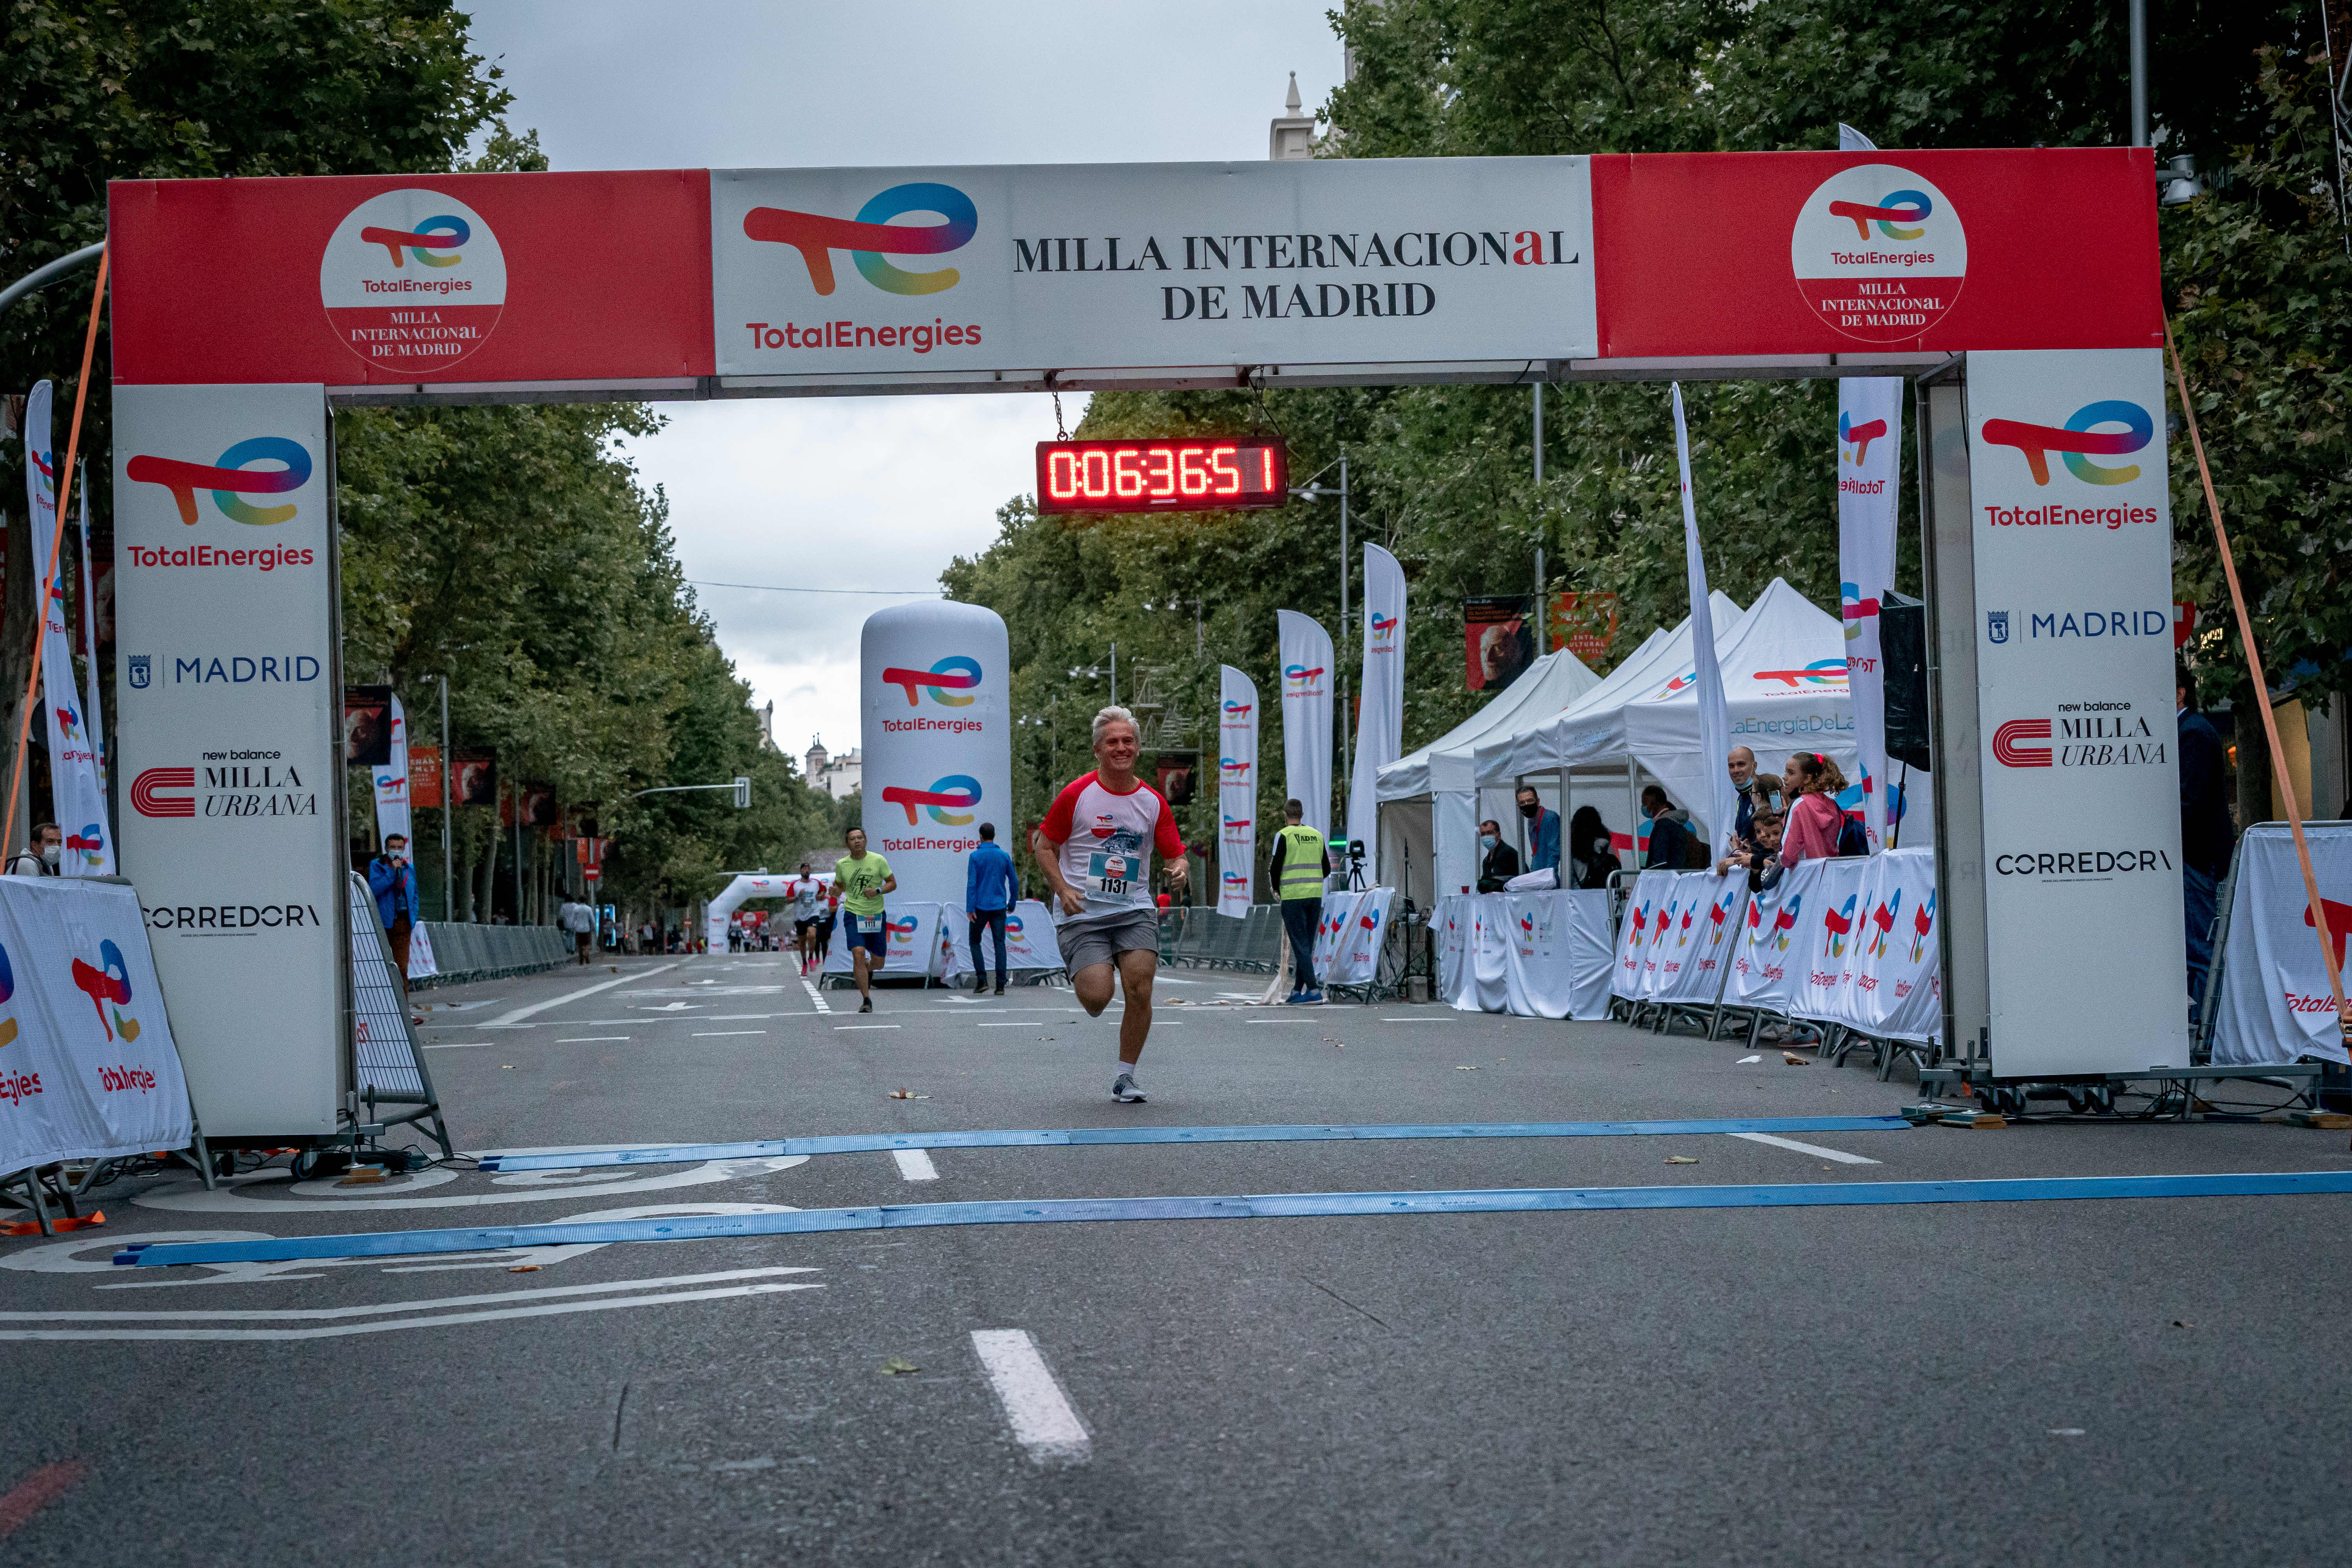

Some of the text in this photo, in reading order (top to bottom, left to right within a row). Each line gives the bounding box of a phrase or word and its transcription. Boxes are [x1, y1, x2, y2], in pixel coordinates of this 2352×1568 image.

[1012, 236, 1172, 272] MILLA
[1831, 250, 1935, 267] TotalEnergies
[362, 278, 472, 295] TotalEnergies
[1859, 283, 1906, 295] MILLA
[1160, 283, 1436, 320] DE MADRID
[391, 312, 441, 325] MILLA
[1842, 314, 1926, 327] DE MADRID
[746, 318, 982, 354] TotalEnergies
[372, 343, 461, 357] DE MADRID
[1984, 503, 2157, 530] TotalEnergies
[127, 543, 314, 572] TotalEnergies
[2032, 610, 2166, 638] MADRID
[176, 656, 320, 683] MADRID
[2058, 701, 2131, 712] new balance
[882, 717, 982, 734] TotalEnergies
[2061, 716, 2151, 739] MILLA
[202, 749, 281, 760] new balance
[2062, 742, 2167, 766] URBANA
[205, 766, 302, 788] MILLA
[205, 793, 318, 817] URBANA
[1100, 877, 1128, 895] 1131
